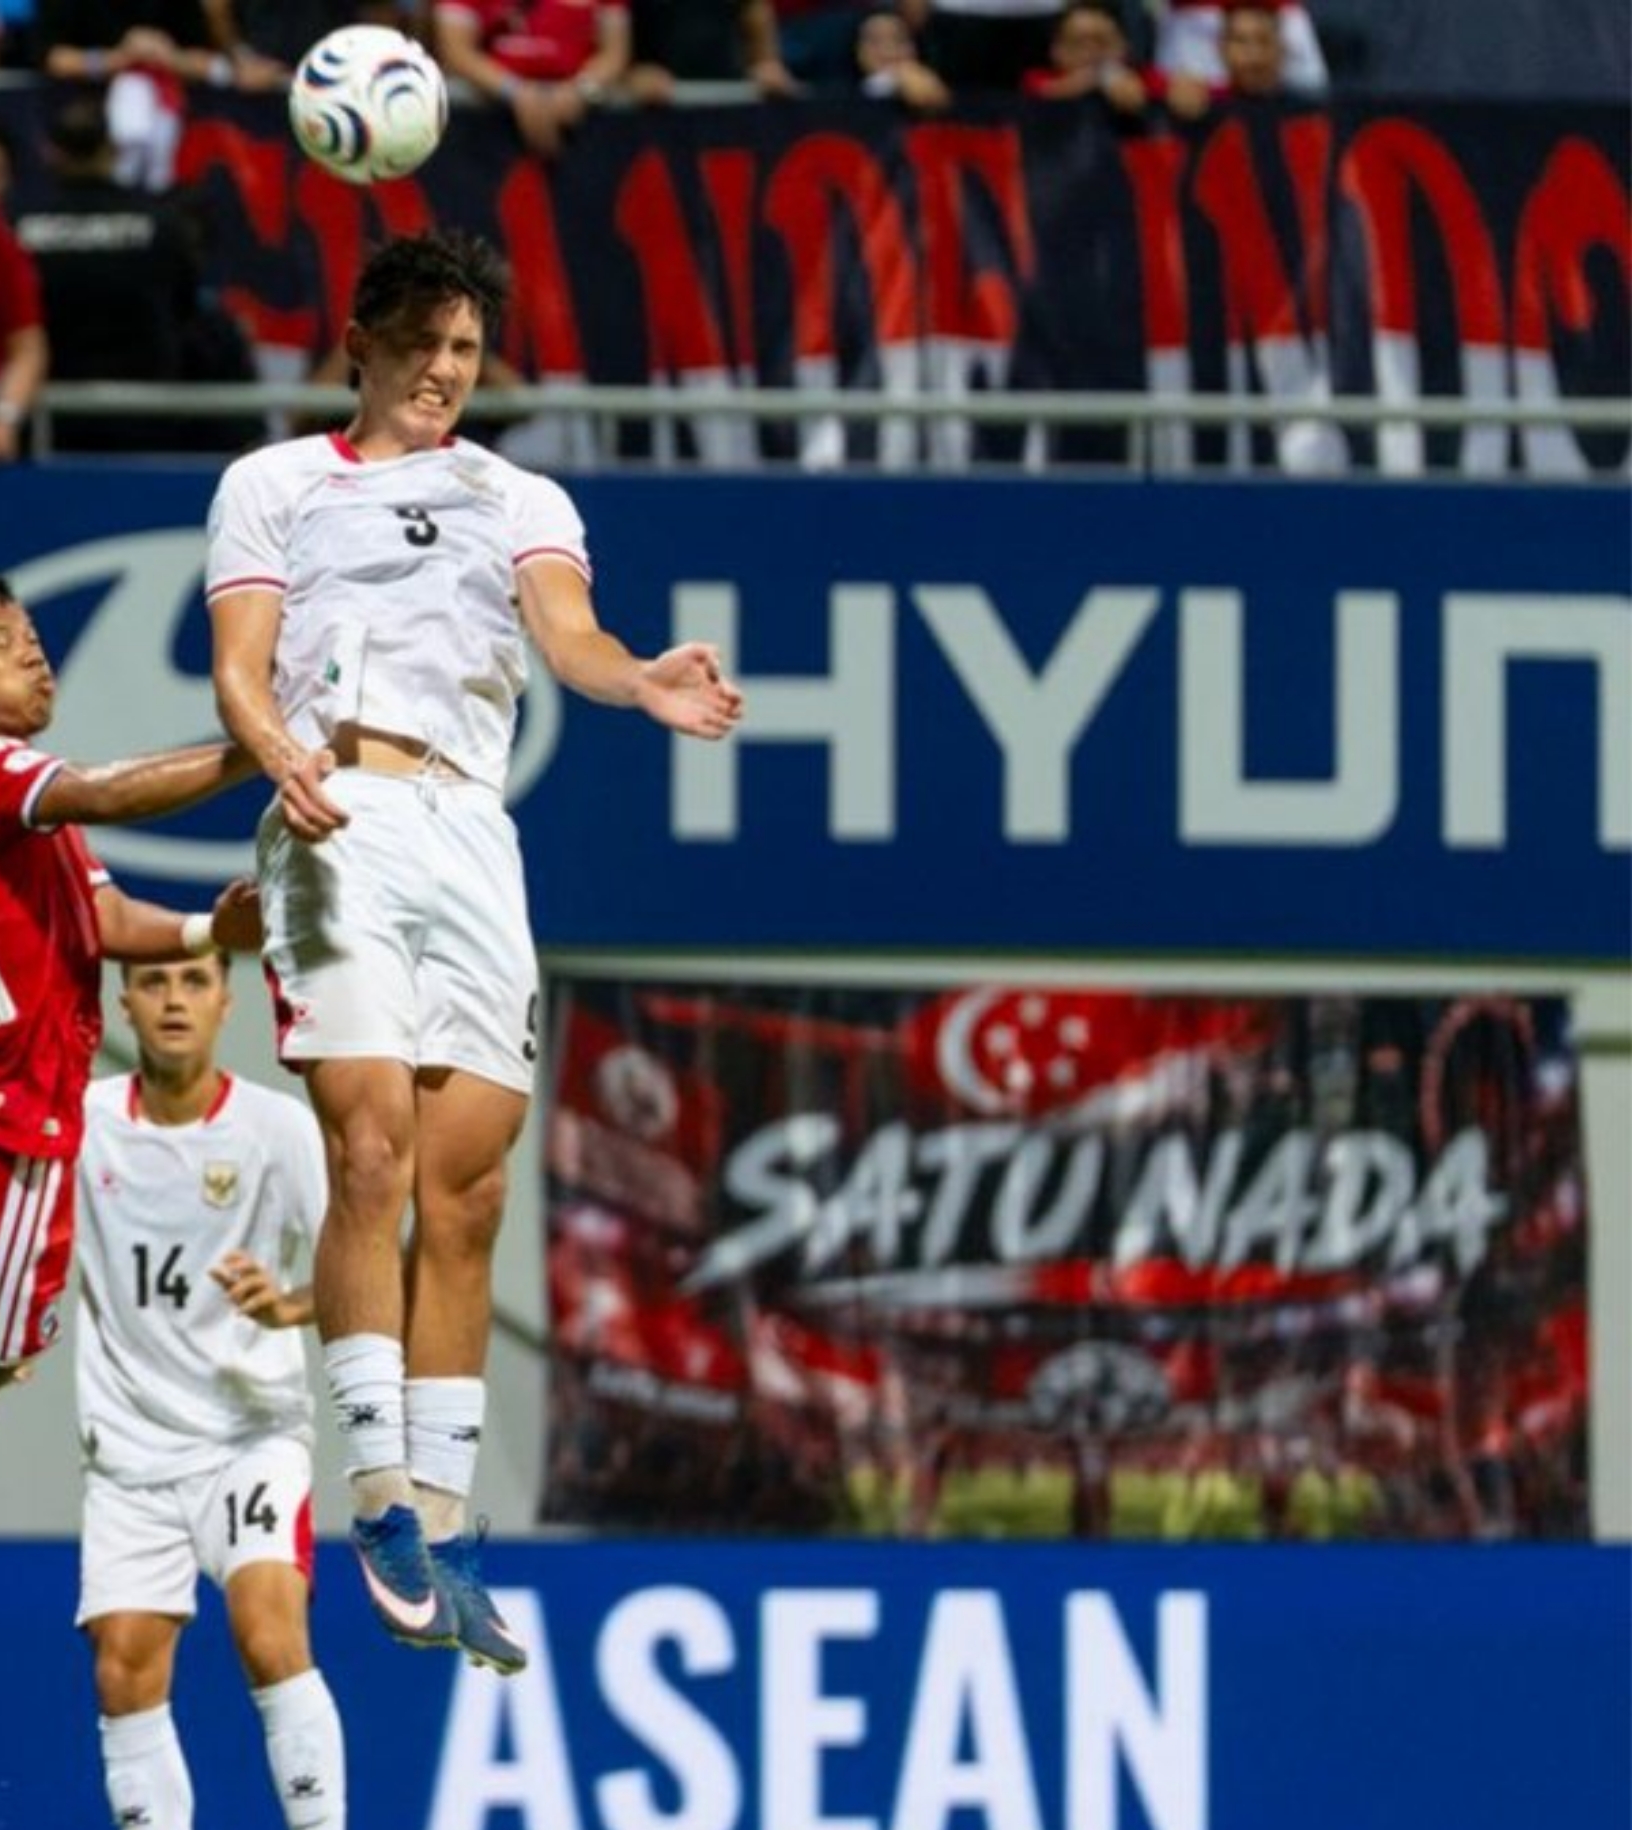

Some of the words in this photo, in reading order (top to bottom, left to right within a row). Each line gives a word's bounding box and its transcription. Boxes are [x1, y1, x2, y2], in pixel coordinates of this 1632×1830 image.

[680, 1112, 1105, 1296] SATU
[1114, 1122, 1510, 1277] NADA
[131, 1242, 192, 1310] 14
[223, 1481, 278, 1549] 14
[424, 1584, 1212, 1830] ASEAN
